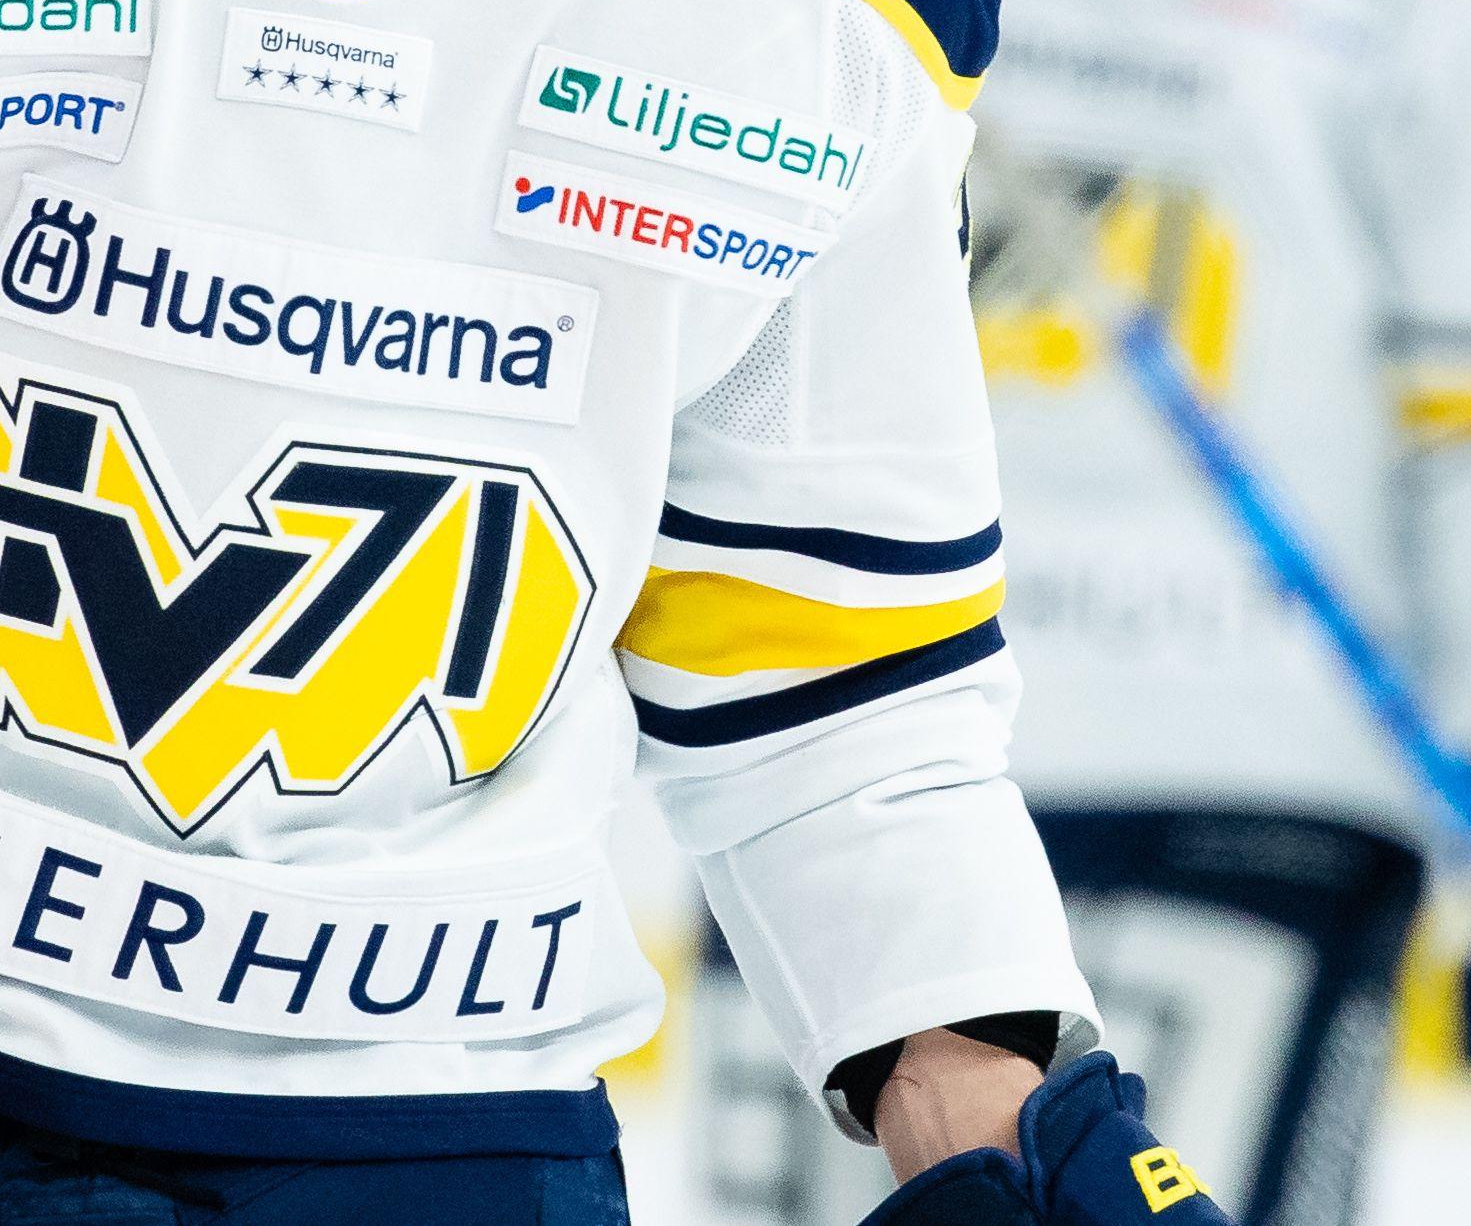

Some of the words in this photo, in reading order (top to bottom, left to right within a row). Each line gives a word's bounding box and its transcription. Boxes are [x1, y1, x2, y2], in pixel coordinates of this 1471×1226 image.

[285, 31, 397, 69] Husqvarna
[606, 76, 865, 192] Liljedahl
[558, 187, 819, 281] INTERSPORT
[92, 234, 556, 391] Husqvarna
